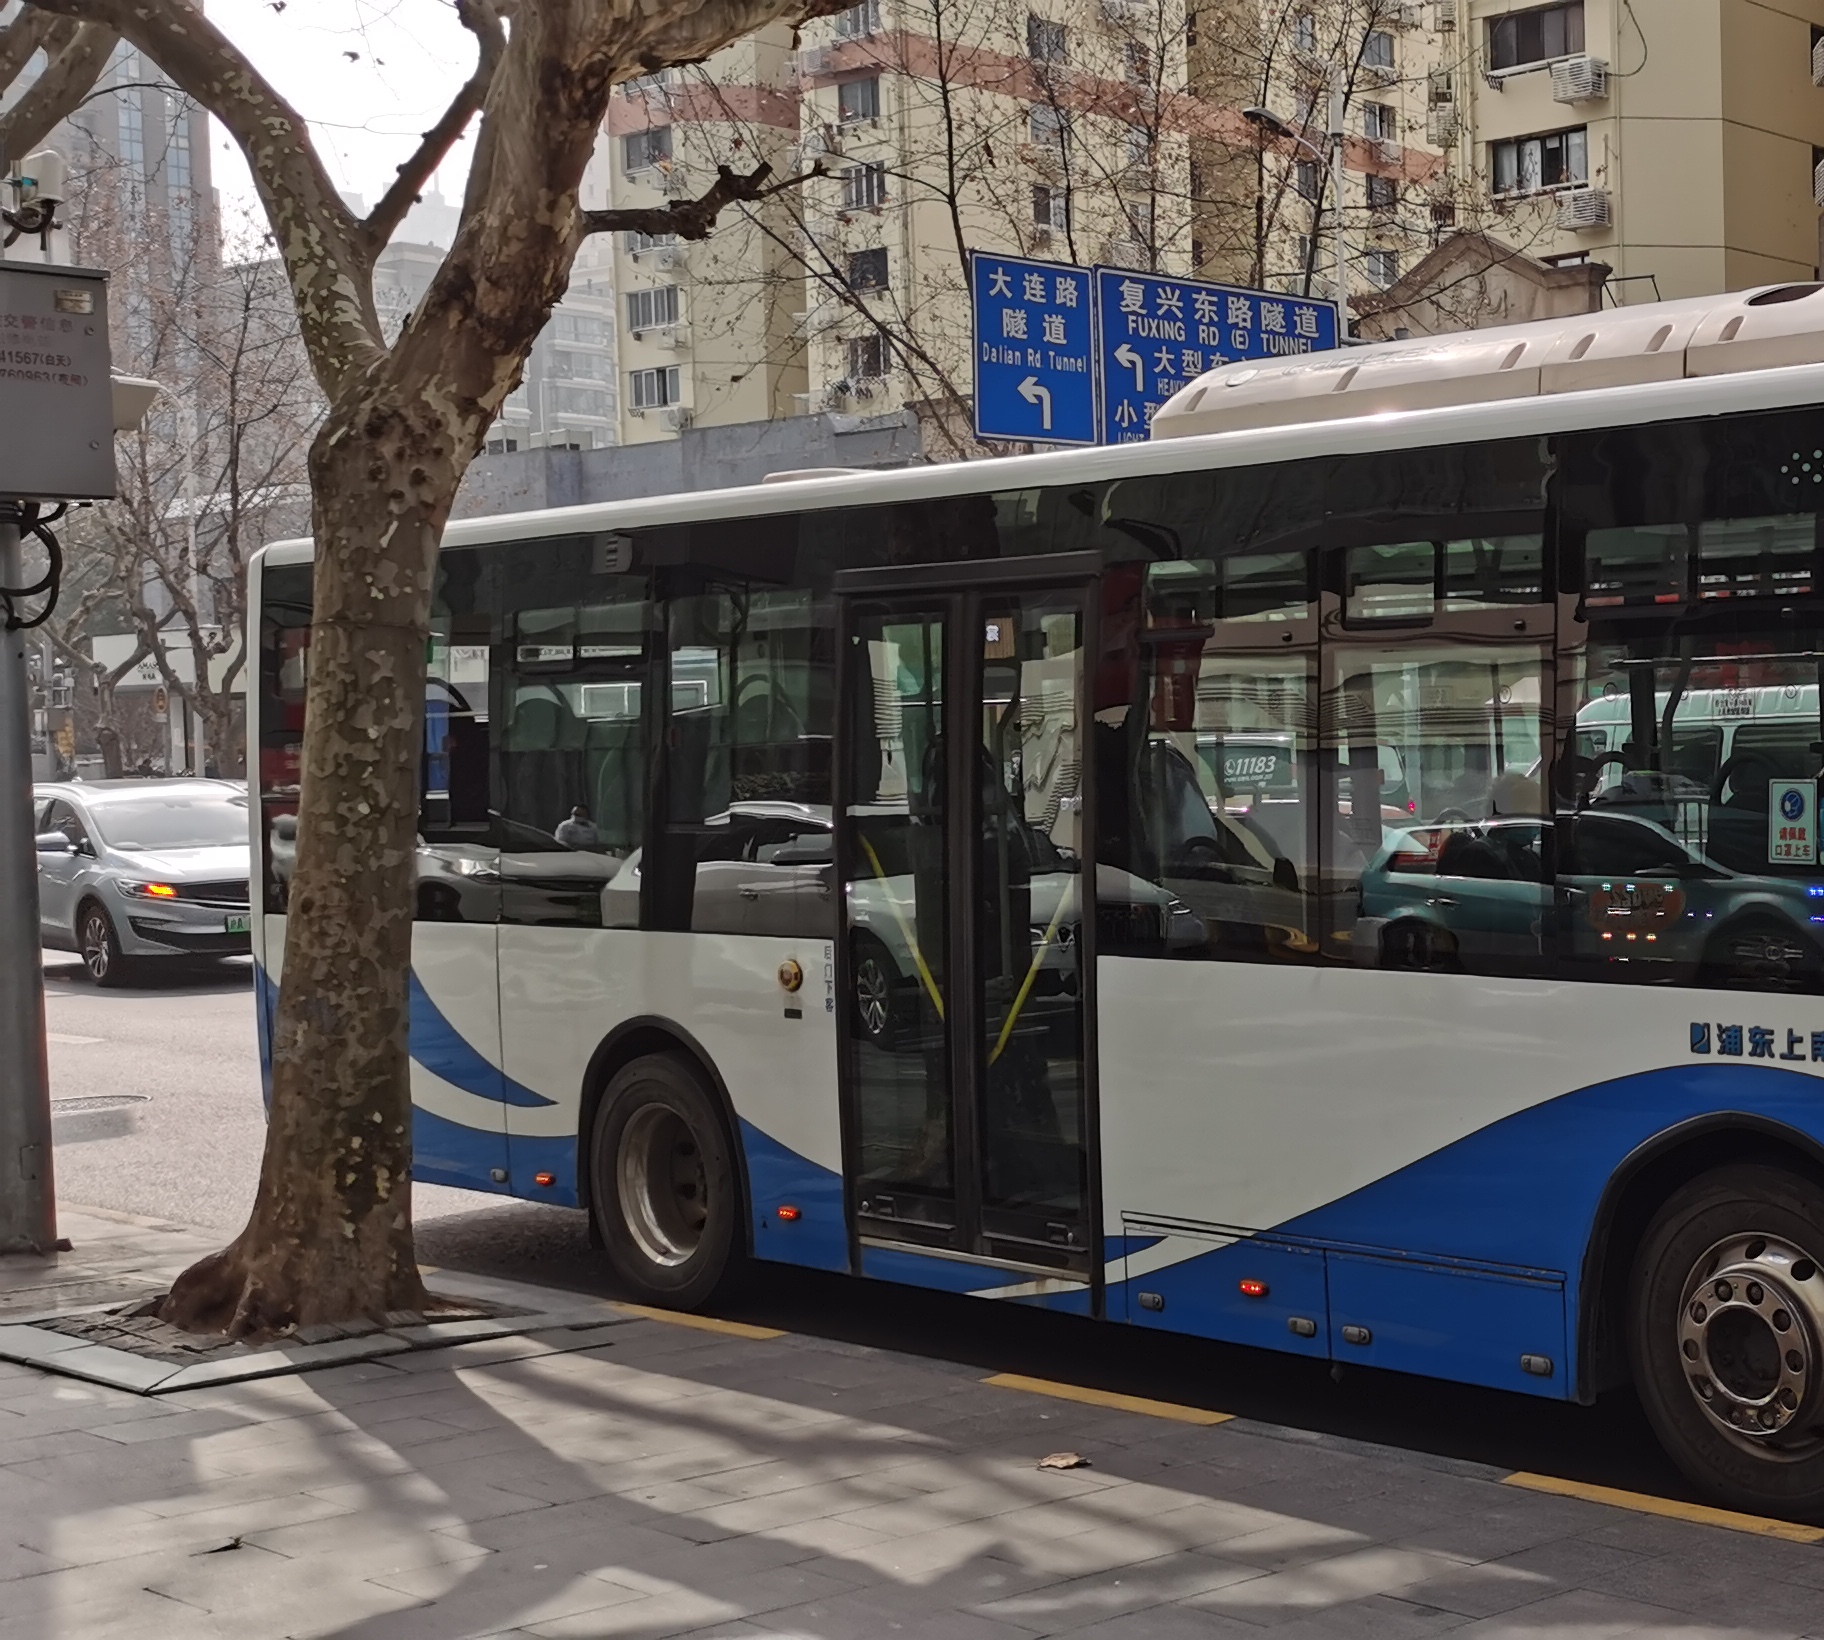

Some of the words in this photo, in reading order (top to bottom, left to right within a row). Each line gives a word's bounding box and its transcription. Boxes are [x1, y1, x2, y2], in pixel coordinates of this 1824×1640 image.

[988, 266, 1078, 308] 大连路
[1119, 279, 1320, 339] 复兴东路隧道
[1002, 307, 1067, 346] 隧道
[1128, 315, 1186, 342] FUXING
[1199, 326, 1220, 347] RD
[1231, 327, 1250, 350] (E)
[982, 341, 1022, 367] Dalian
[1027, 347, 1043, 369] Rd
[1048, 349, 1087, 373] Tunnel
[1153, 345, 1247, 377] 大型车
[1235, 755, 1277, 775] 11183
[1774, 844, 1811, 857] 口罩上车
